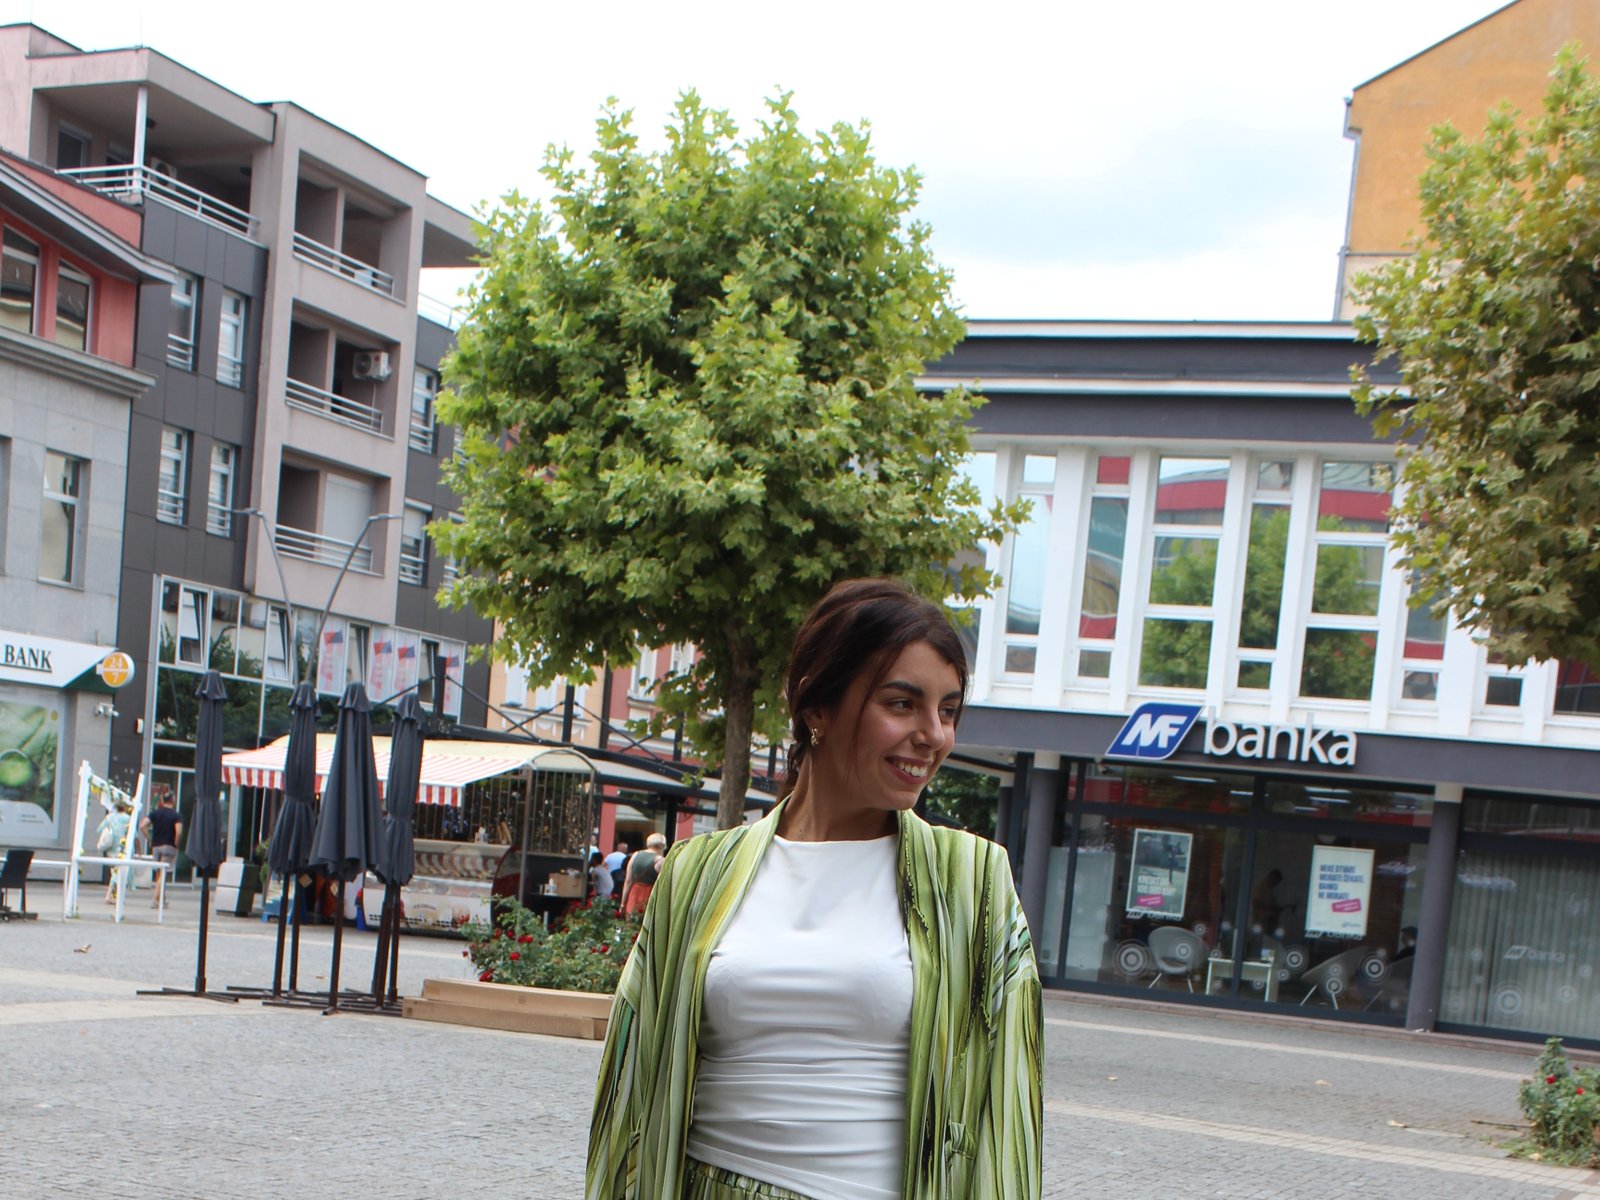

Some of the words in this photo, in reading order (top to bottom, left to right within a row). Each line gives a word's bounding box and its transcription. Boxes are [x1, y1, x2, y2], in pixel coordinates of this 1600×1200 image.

[4, 644, 52, 670] BANK
[110, 656, 123, 669] 24
[112, 672, 120, 684] 7
[1121, 713, 1187, 748] MF
[1204, 706, 1357, 766] banka
